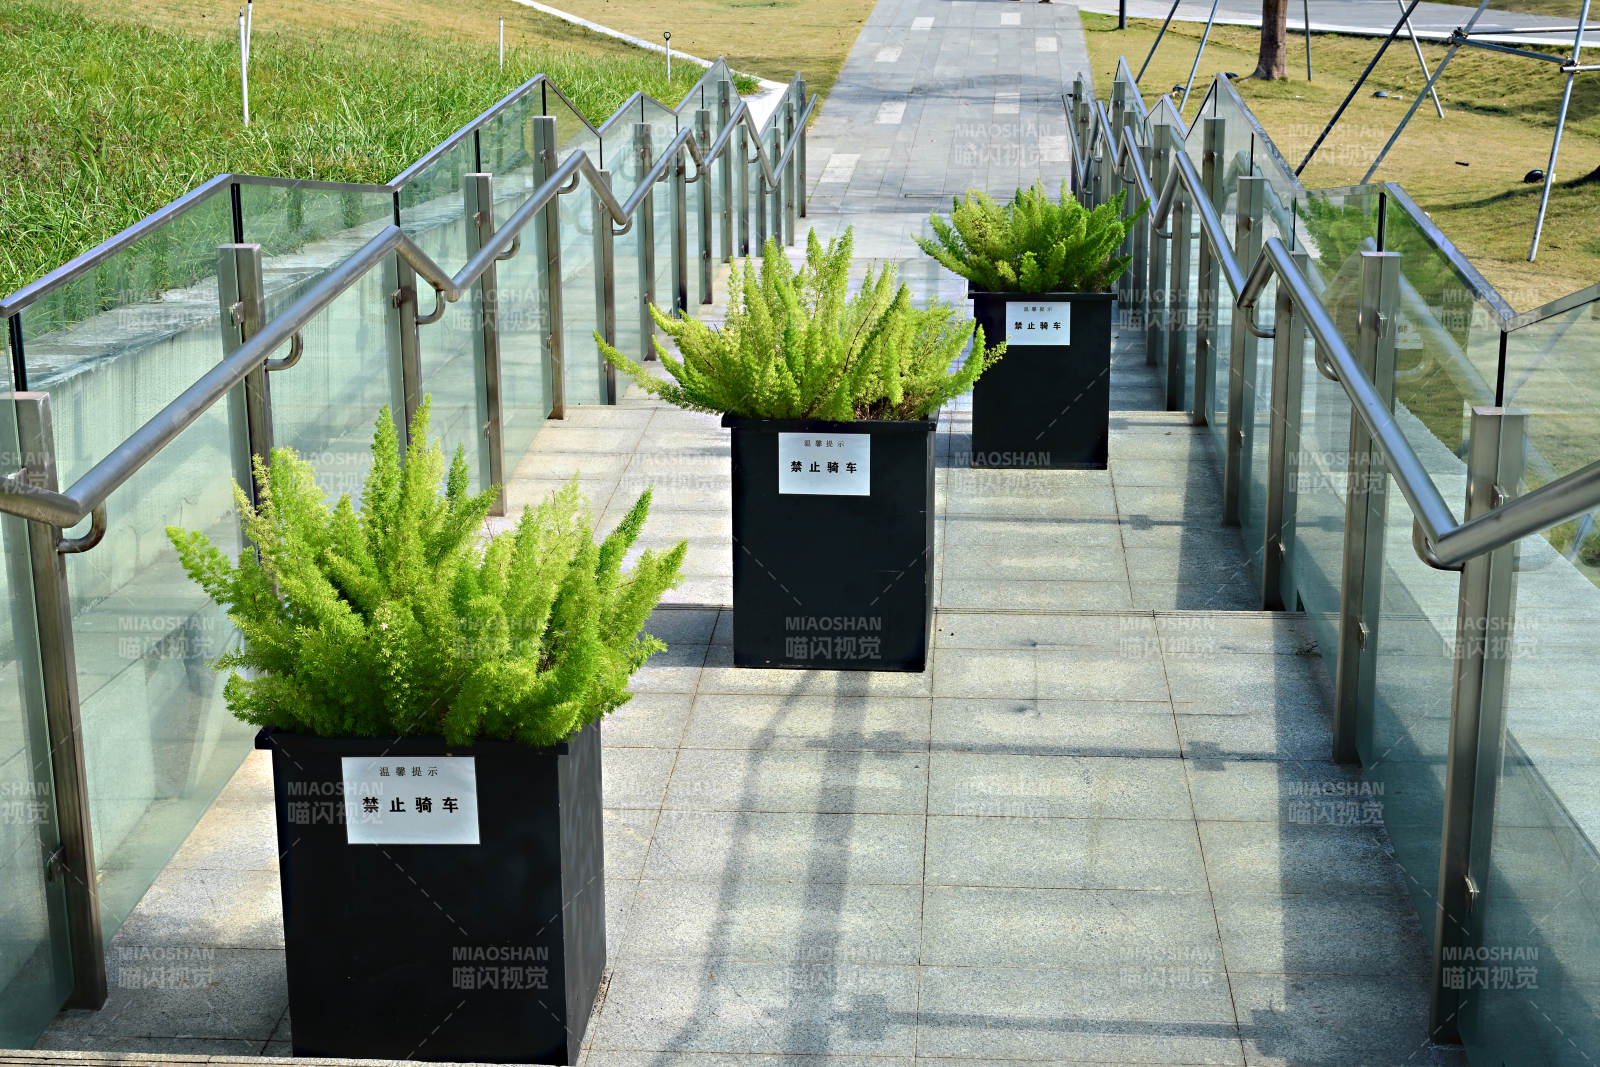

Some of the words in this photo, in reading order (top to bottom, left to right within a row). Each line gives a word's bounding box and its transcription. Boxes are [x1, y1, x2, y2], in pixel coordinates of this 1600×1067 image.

[790, 460, 857, 474] 禁止骑车
[379, 766, 439, 777] 温馨提示
[362, 796, 459, 814] 禁止骑车
